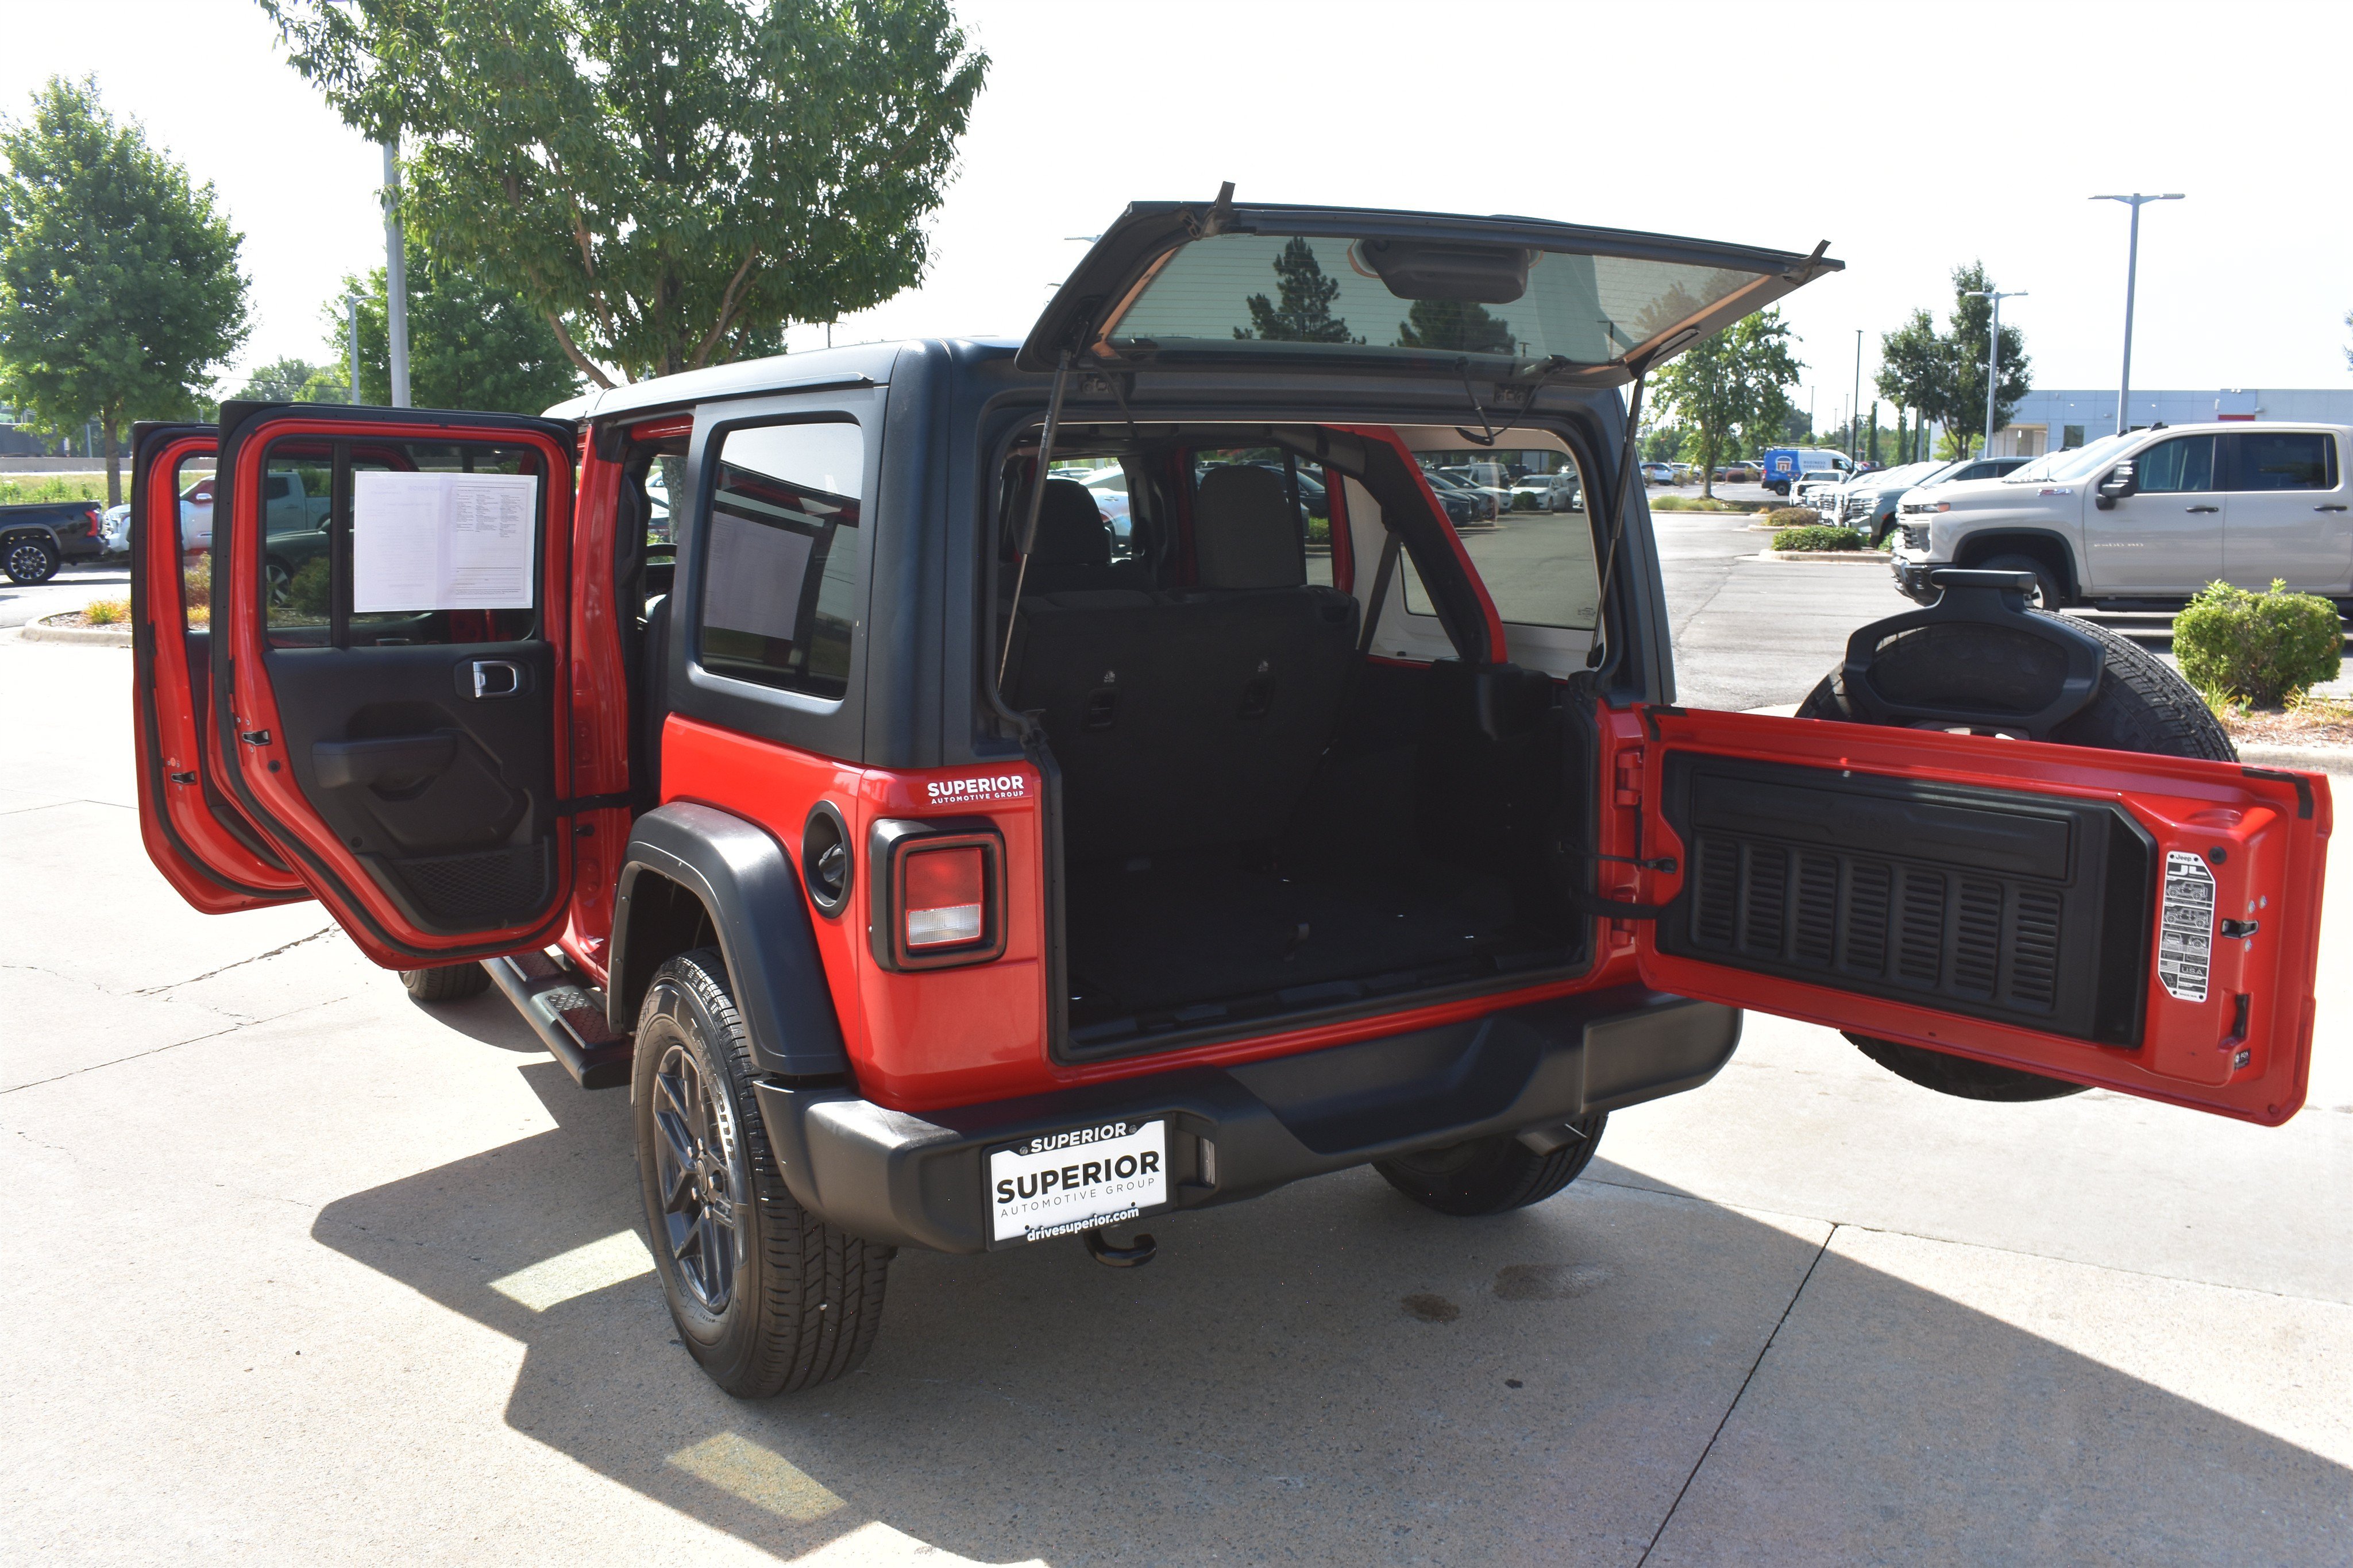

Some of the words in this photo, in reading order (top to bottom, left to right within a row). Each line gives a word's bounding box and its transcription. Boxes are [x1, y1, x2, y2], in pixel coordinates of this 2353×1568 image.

[927, 775, 1024, 797] SUPERIOR
[931, 793, 990, 805] AUTOMOTIVE
[994, 790, 1024, 799] GROUP
[2175, 854, 2192, 862] Jeep
[2168, 864, 2208, 876] JL
[2181, 966, 2204, 976] USA
[1030, 1122, 1127, 1153] SUPERIOR
[997, 1150, 1160, 1204] SUPERIOR
[1001, 1189, 1097, 1218] AUTOMOTIVE
[1106, 1177, 1155, 1195] GROUP
[1027, 1206, 1139, 1242] drivesuperior.com
